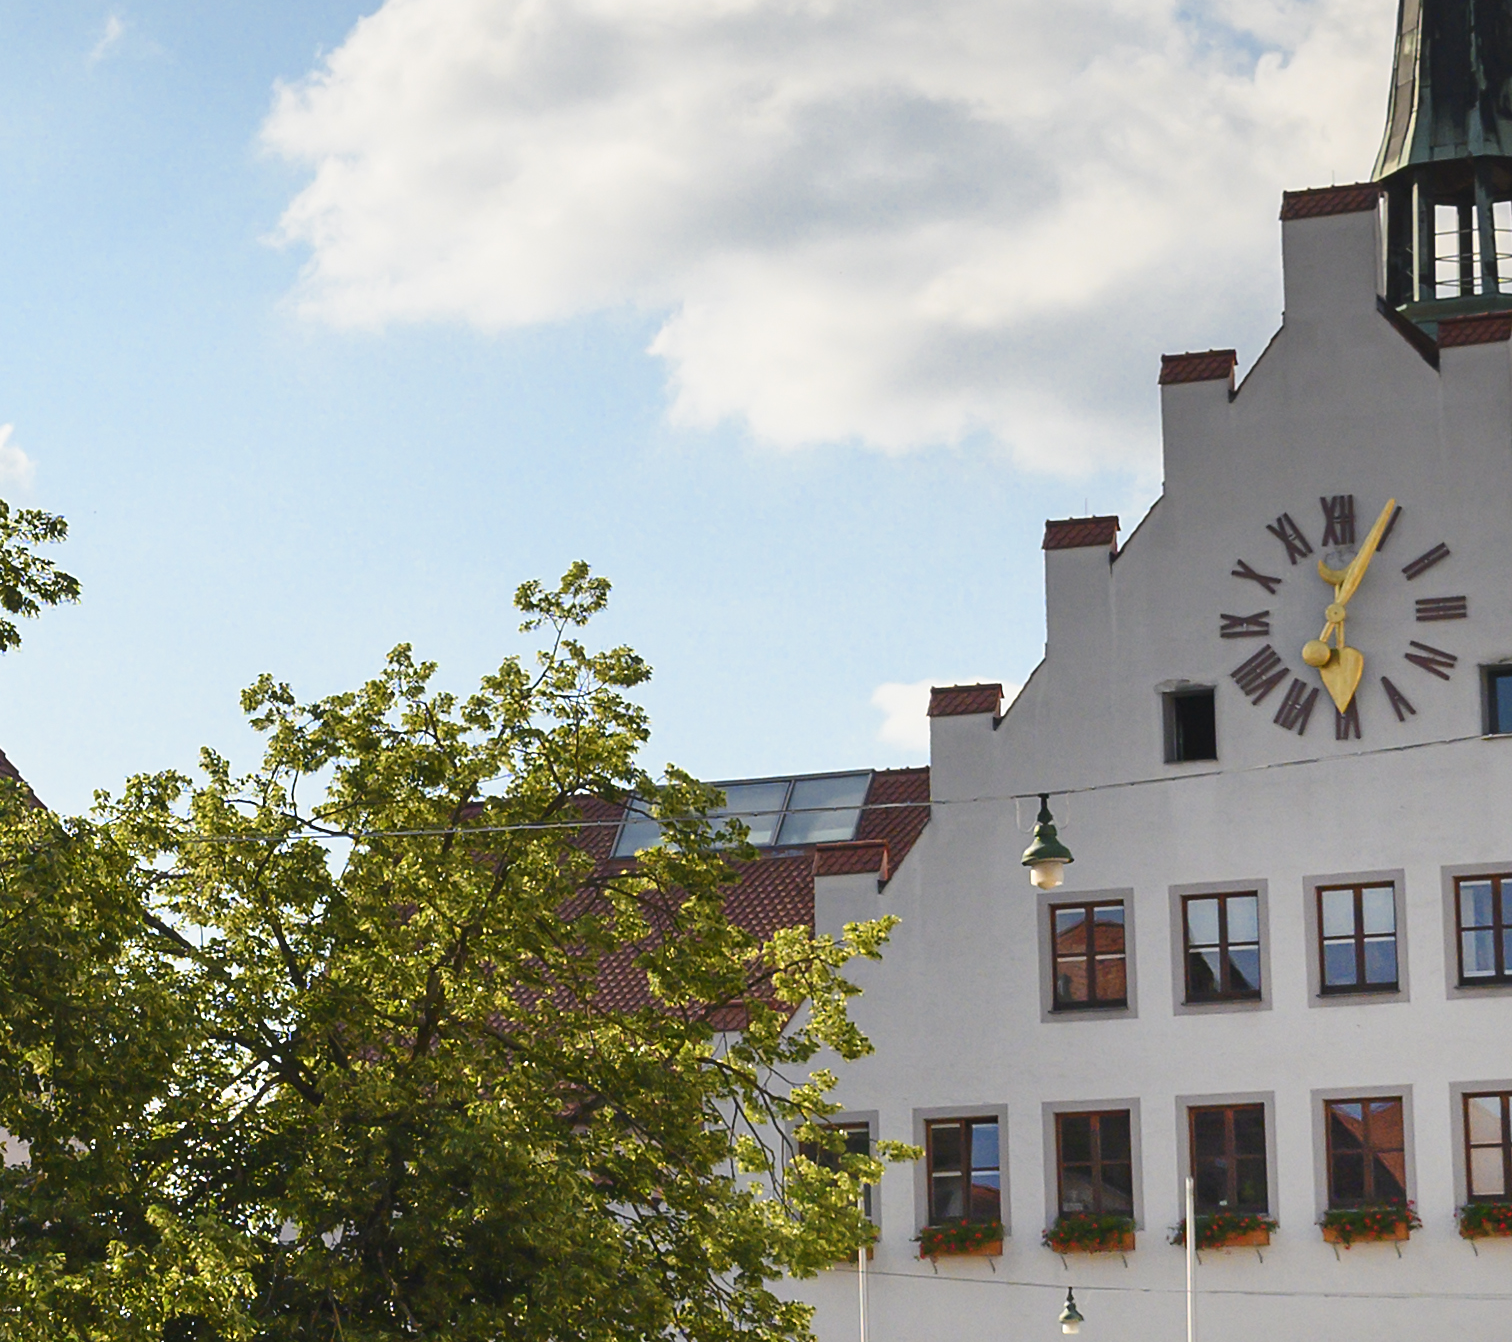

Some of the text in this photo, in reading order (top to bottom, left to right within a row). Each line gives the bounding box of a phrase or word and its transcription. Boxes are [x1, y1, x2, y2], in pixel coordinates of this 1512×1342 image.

[1320, 494, 1355, 546] XII
[1231, 559, 1282, 594] X
[1415, 595, 1467, 621] III
